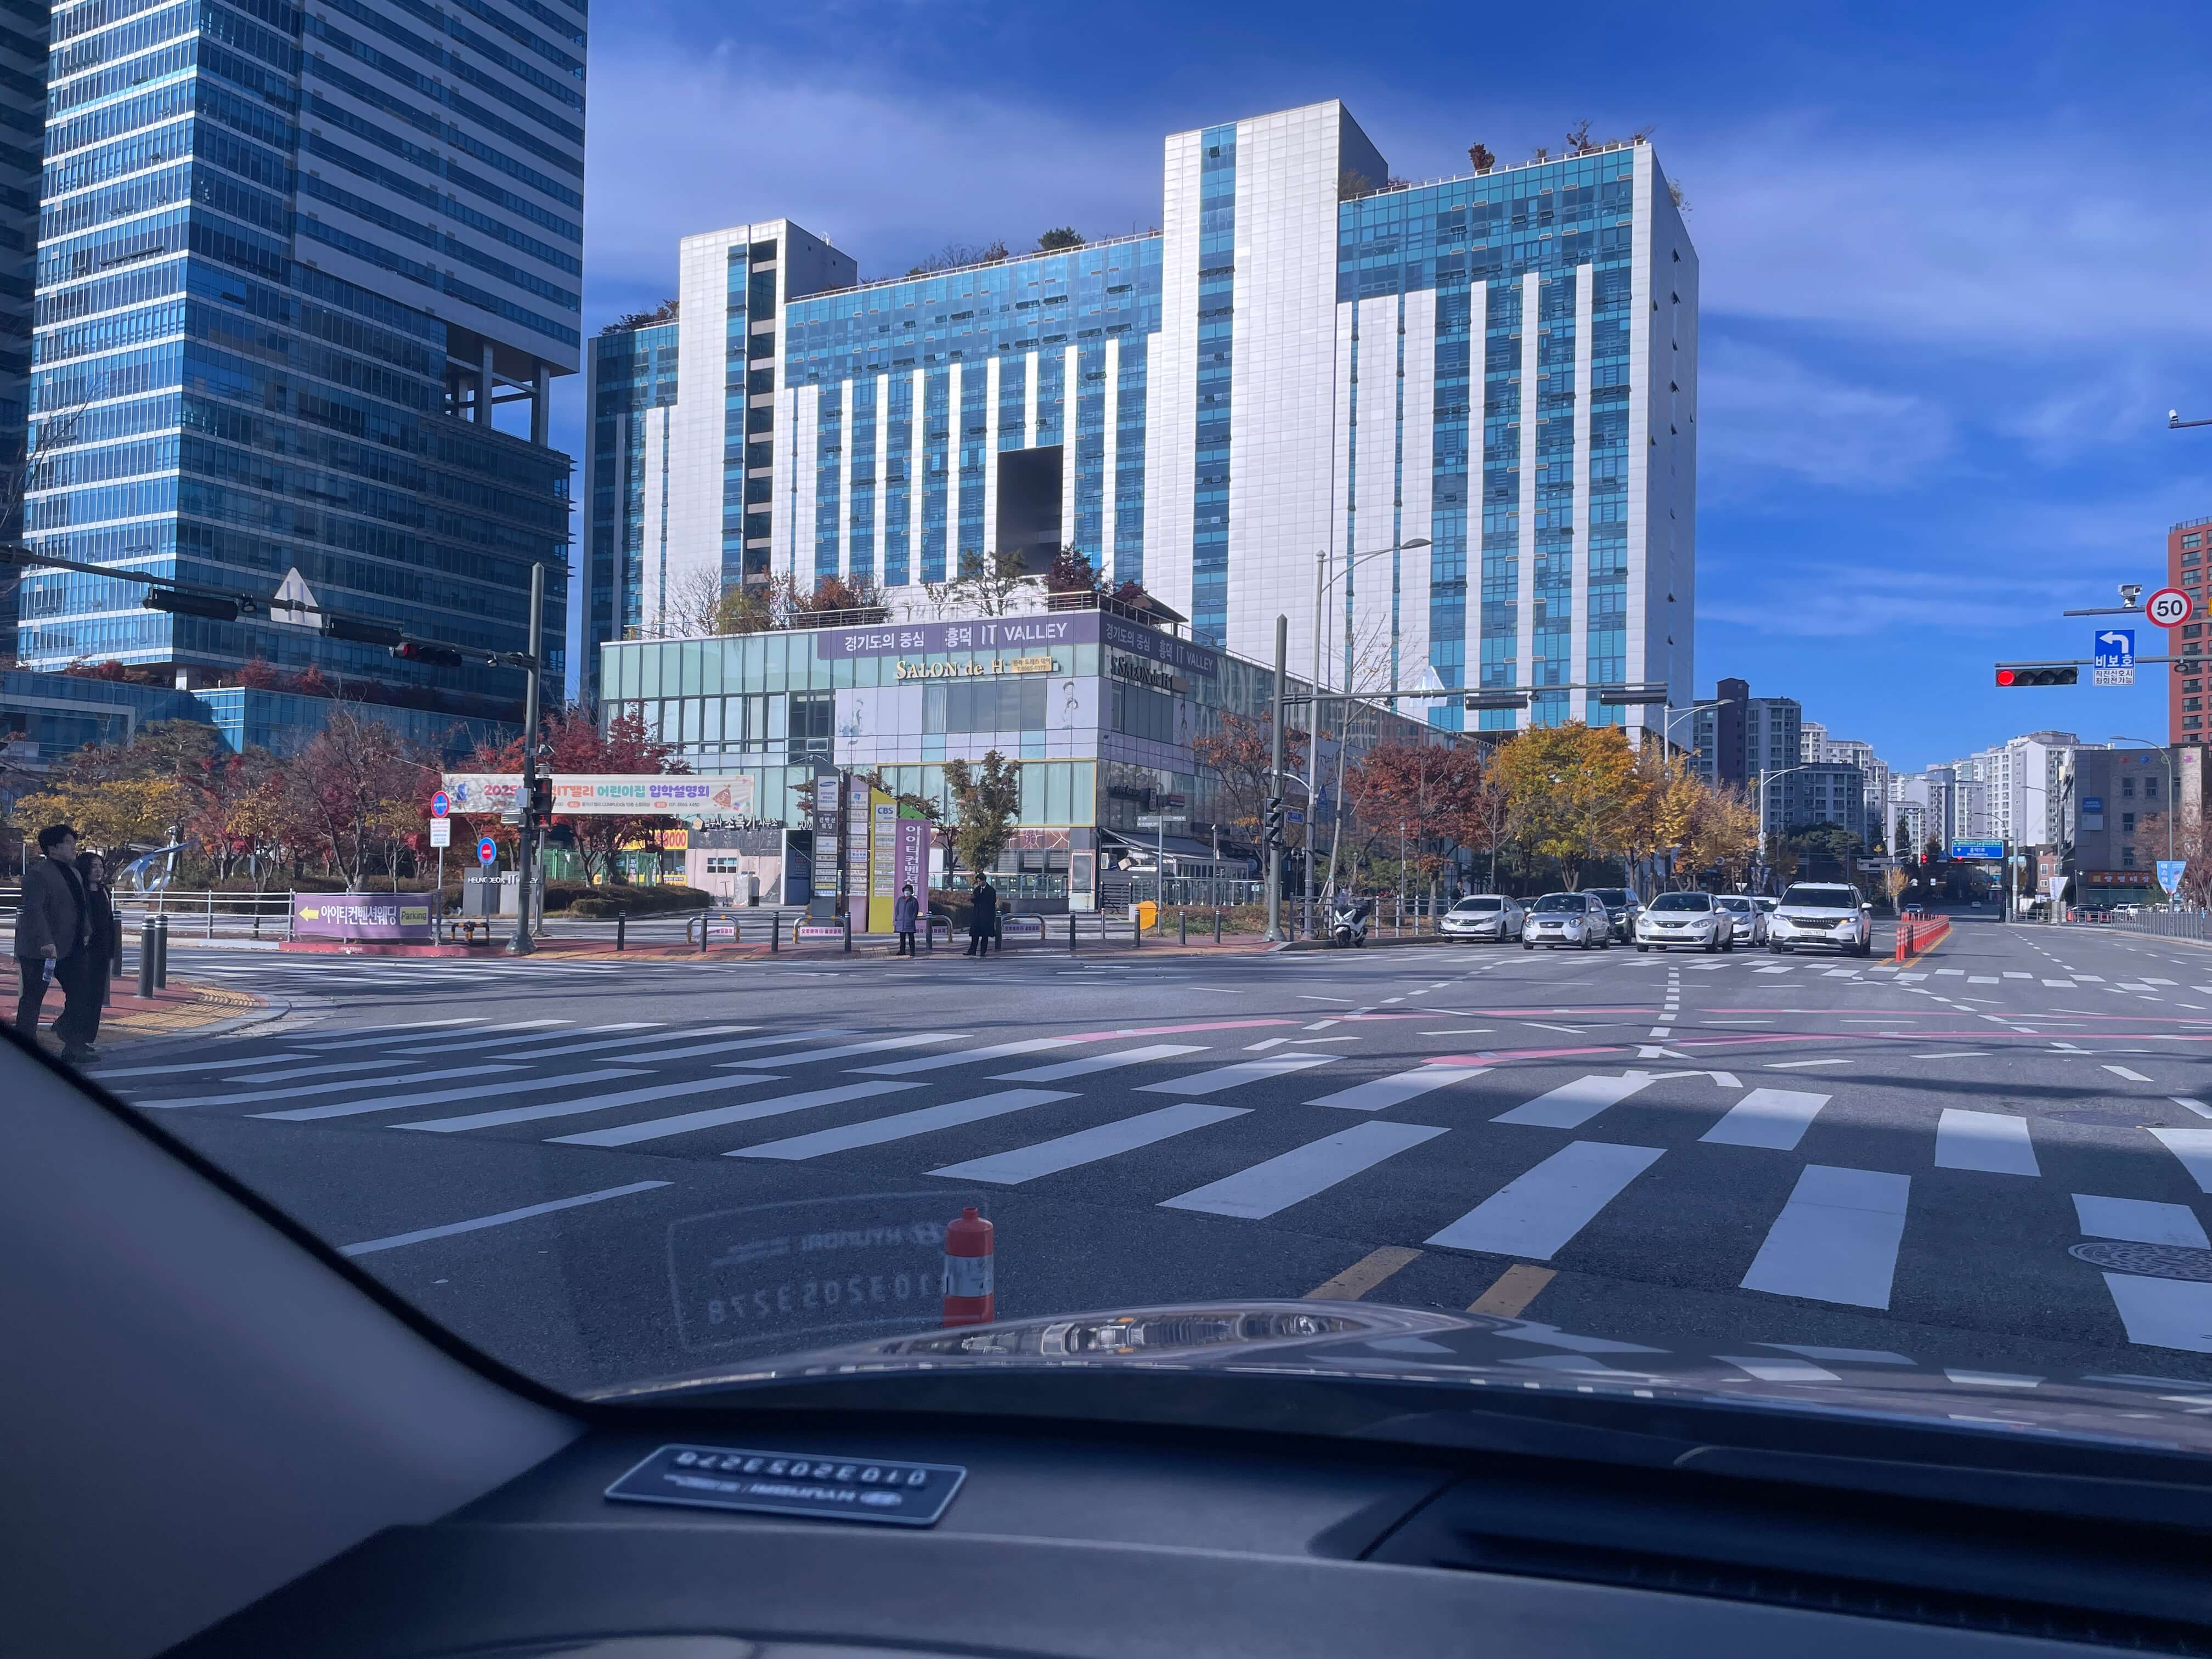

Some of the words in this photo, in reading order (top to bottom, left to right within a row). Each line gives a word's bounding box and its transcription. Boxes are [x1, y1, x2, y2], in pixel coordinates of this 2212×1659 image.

[2157, 600, 2182, 617] 50
[845, 633, 895, 652] 경기도의
[899, 631, 924, 648] 중심
[945, 627, 972, 648] 흥덕
[981, 625, 997, 645] IT
[1004, 623, 1068, 641] VALLEY
[1106, 623, 1134, 647] 경기도의
[1137, 634, 1150, 652] 중심
[1159, 640, 1172, 662] 흥덕
[1176, 645, 1184, 665] IT
[1187, 651, 1214, 672] VALLEY
[896, 661, 958, 680] SALON
[966, 659, 984, 676] de
[992, 659, 1005, 674] H
[2095, 654, 2134, 668] 비보호
[484, 785, 522, 796] 2025
[597, 785, 646, 798] 어린이집
[649, 785, 710, 798] 입학설명회
[758, 817, 778, 827] 사무소
[904, 825, 923, 900] 아이티컨벤션
[321, 905, 397, 926] 아이티컨벤션웨딩
[401, 911, 427, 921] Parking
